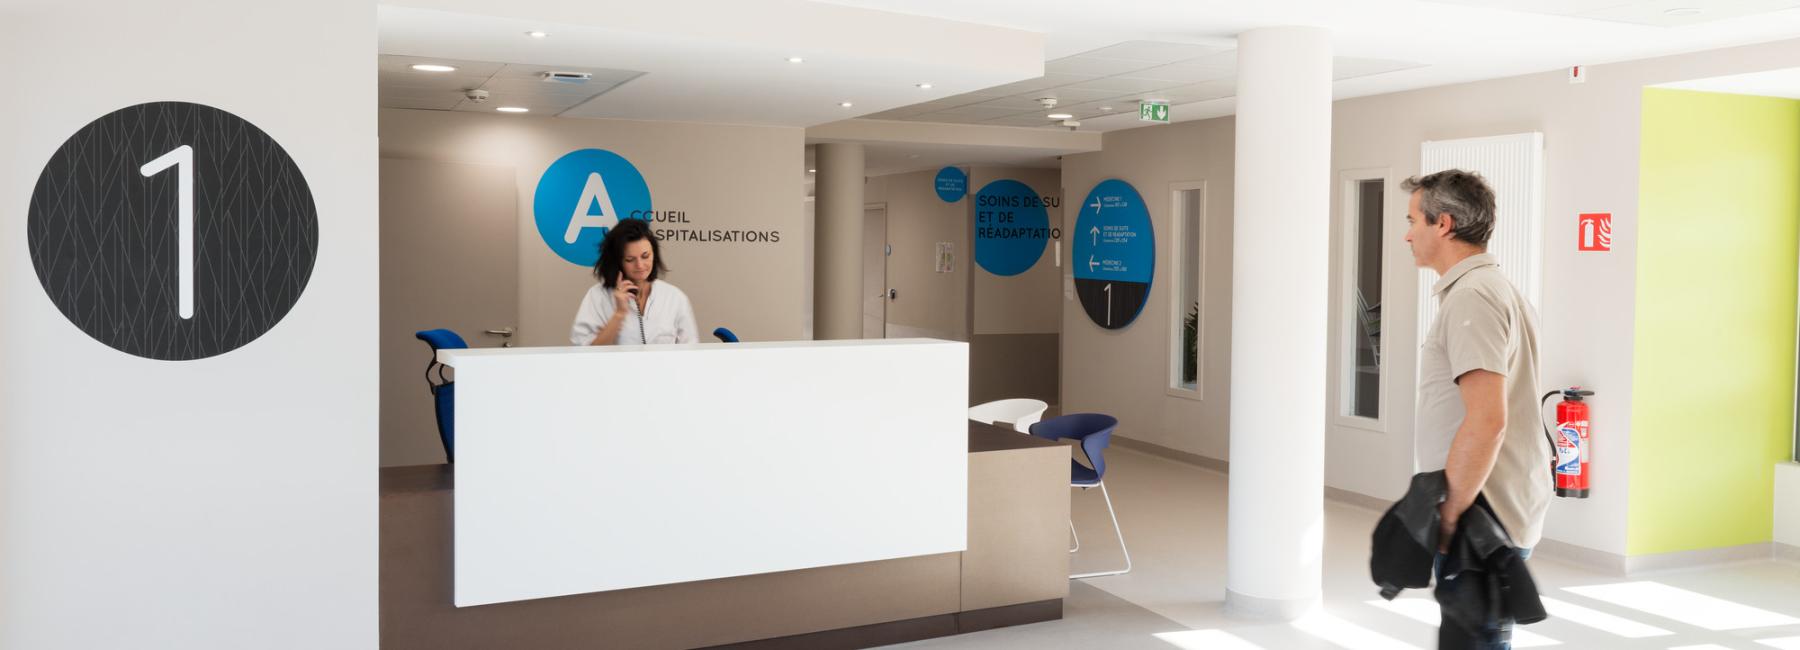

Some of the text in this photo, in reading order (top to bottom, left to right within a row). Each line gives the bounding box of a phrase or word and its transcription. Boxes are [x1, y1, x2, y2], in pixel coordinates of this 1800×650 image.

[564, 171, 620, 244] A
[978, 195, 1060, 209] SOINS DE SU
[978, 211, 1015, 223] ET DE
[140, 144, 194, 320] 1
[655, 228, 781, 243] SPITALISATIONS
[978, 224, 1061, 240] RÉADAPTATIO
[1103, 283, 1111, 326] 1
